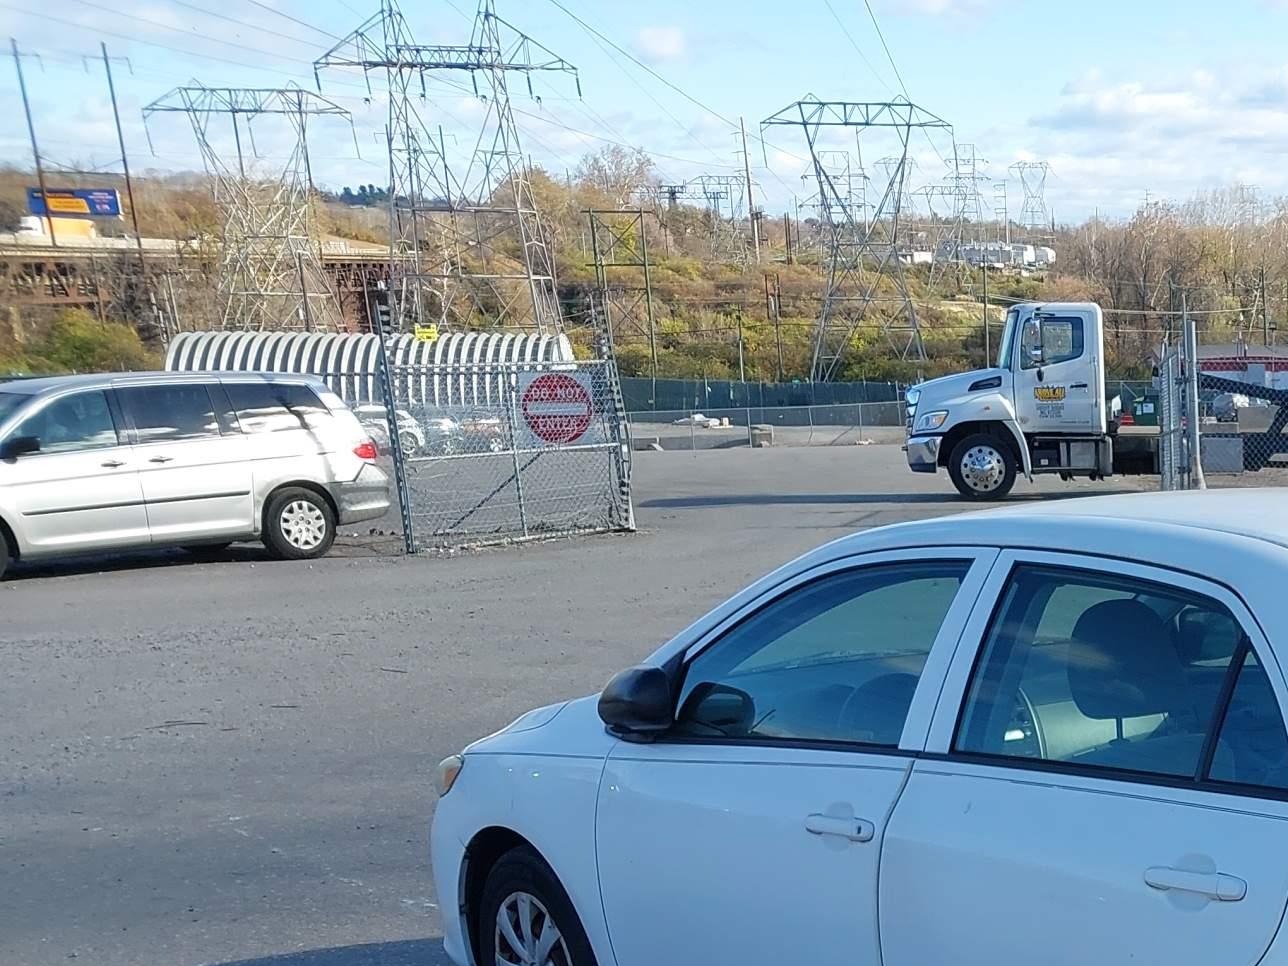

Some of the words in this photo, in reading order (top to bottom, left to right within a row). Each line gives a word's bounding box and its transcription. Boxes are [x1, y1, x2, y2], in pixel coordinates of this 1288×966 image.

[531, 387, 548, 399] DO
[557, 387, 581, 399] NOT
[538, 418, 577, 430] ENTER
